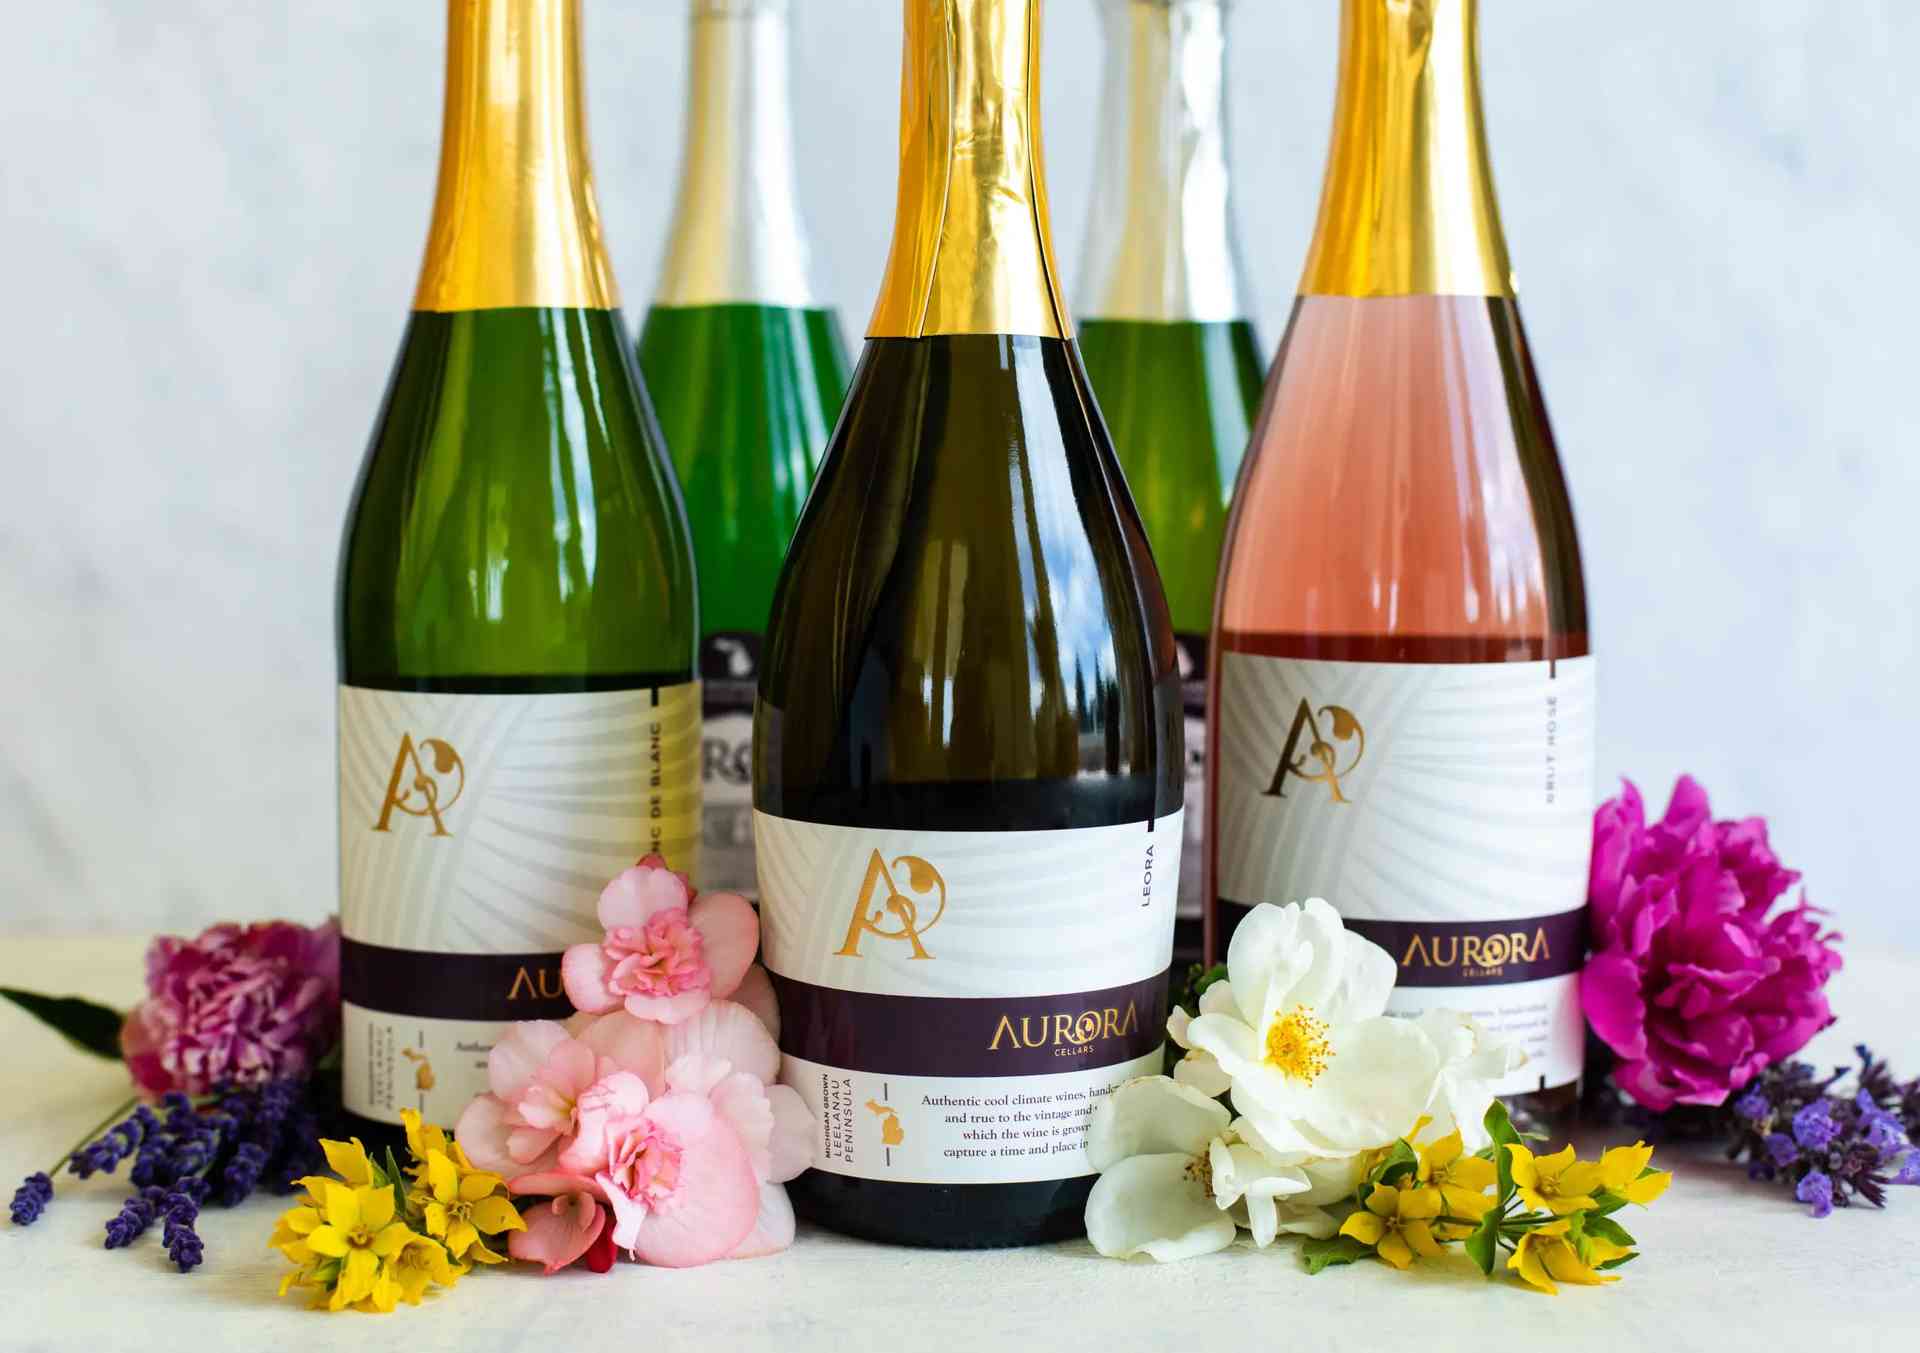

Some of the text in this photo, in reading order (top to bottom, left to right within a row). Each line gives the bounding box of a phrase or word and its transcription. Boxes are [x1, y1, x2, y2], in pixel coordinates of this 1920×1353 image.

[1141, 844, 1154, 907] LEORA
[1401, 927, 1552, 968] AURORA
[506, 967, 563, 1000] AU
[987, 1000, 1138, 1051] AURORA
[1054, 1045, 1095, 1057] CELLARS
[921, 1095, 982, 1106] Authentic
[984, 1095, 1009, 1106] cool
[1011, 1093, 1053, 1106] climate
[1055, 1091, 1086, 1102] wines,
[945, 1103, 1092, 1124] and true to the vintage and
[832, 1080, 842, 1157] LEELANAU
[843, 1078, 854, 1163] PENINSULA
[962, 1129, 998, 1140] which
[1001, 1129, 1020, 1139] the
[1022, 1128, 1049, 1138] wine
[1052, 1126, 1060, 1136] is
[943, 1147, 987, 1159] capture
[990, 1149, 997, 1157] a
[1000, 1146, 1025, 1156] time
[1028, 1143, 1049, 1155] and
[1052, 1141, 1077, 1154] place
